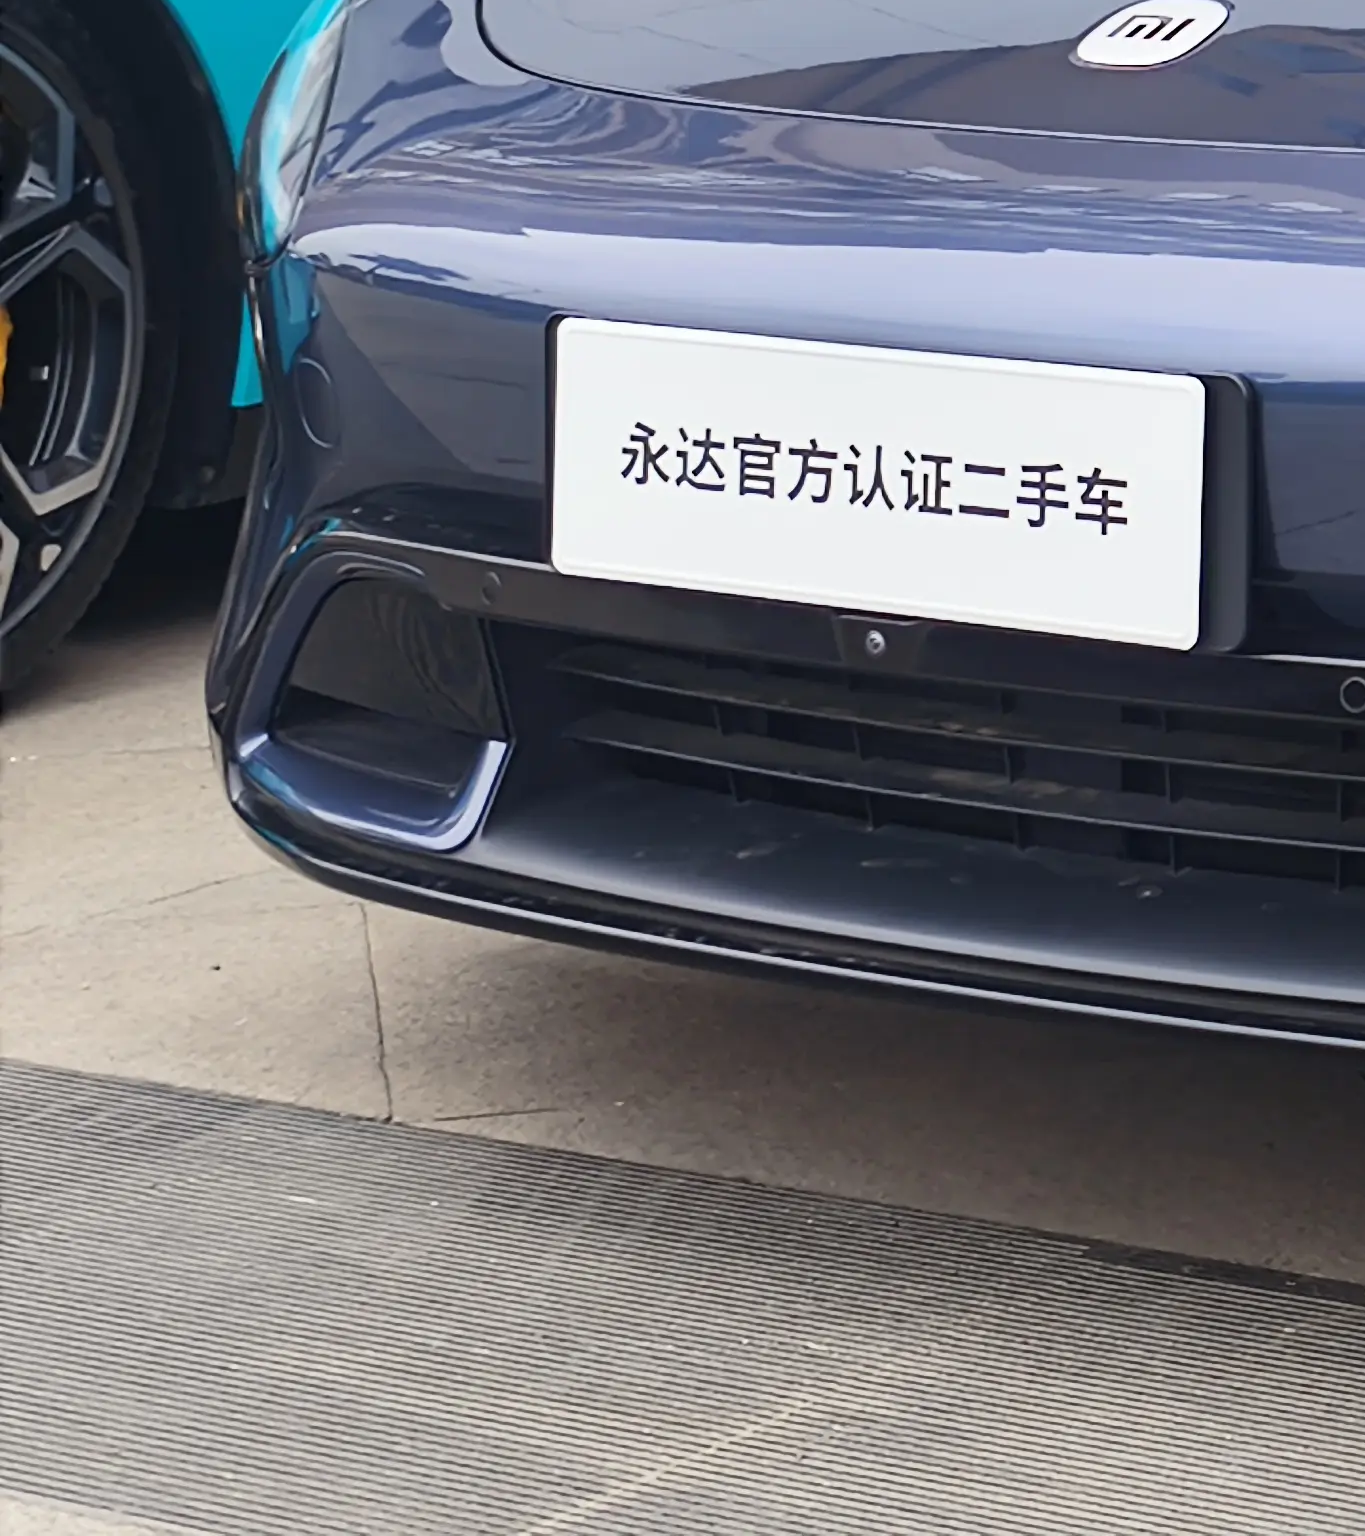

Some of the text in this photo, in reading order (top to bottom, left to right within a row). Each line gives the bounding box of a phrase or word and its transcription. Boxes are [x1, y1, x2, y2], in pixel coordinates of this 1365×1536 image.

[620, 421, 1129, 537] 永达官方认证二手车
